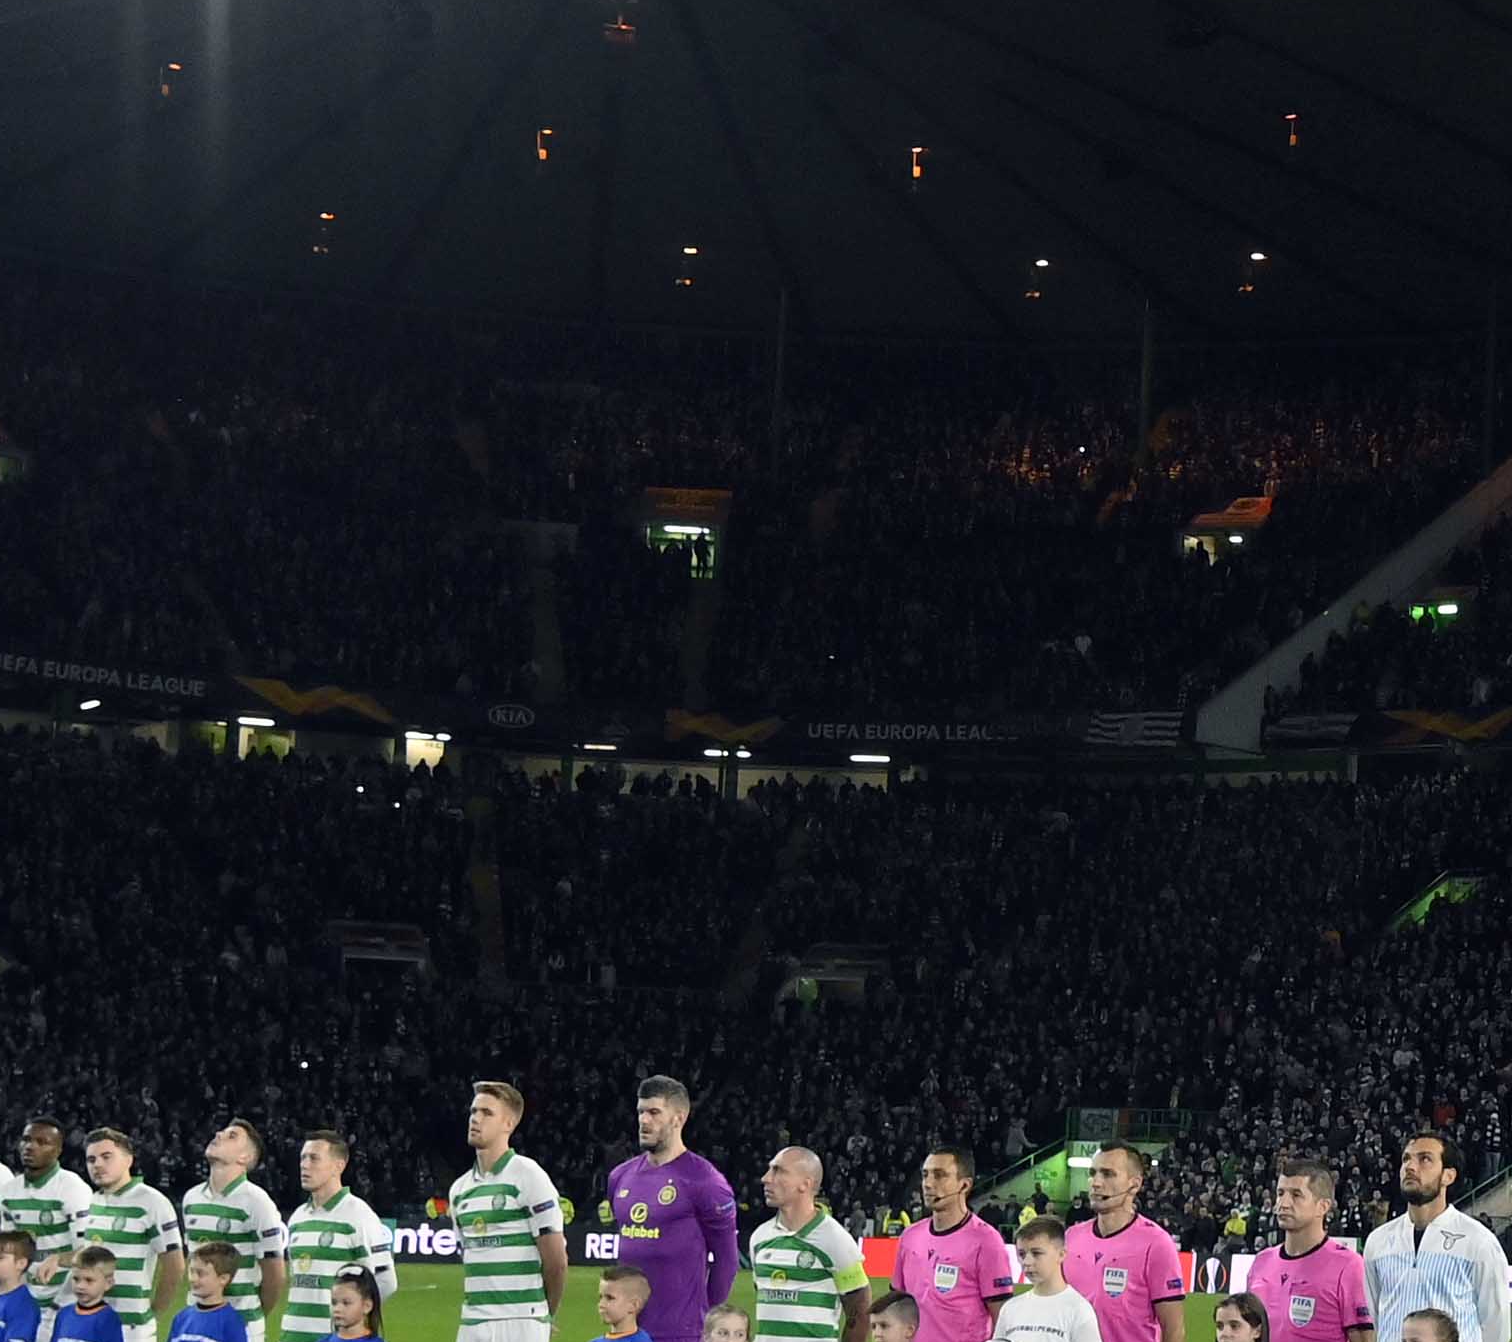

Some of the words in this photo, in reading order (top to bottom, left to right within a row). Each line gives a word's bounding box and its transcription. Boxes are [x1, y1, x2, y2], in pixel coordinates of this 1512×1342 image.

[43, 657, 120, 686] EUROPA
[126, 668, 208, 699] LEAGUE
[496, 709, 528, 724] KIA
[807, 722, 859, 740] UEFA
[865, 722, 940, 740] EUROPA
[937, 1265, 956, 1276] FIFA
[1105, 1269, 1125, 1279] FIFA
[1292, 1297, 1312, 1308] FIFA
